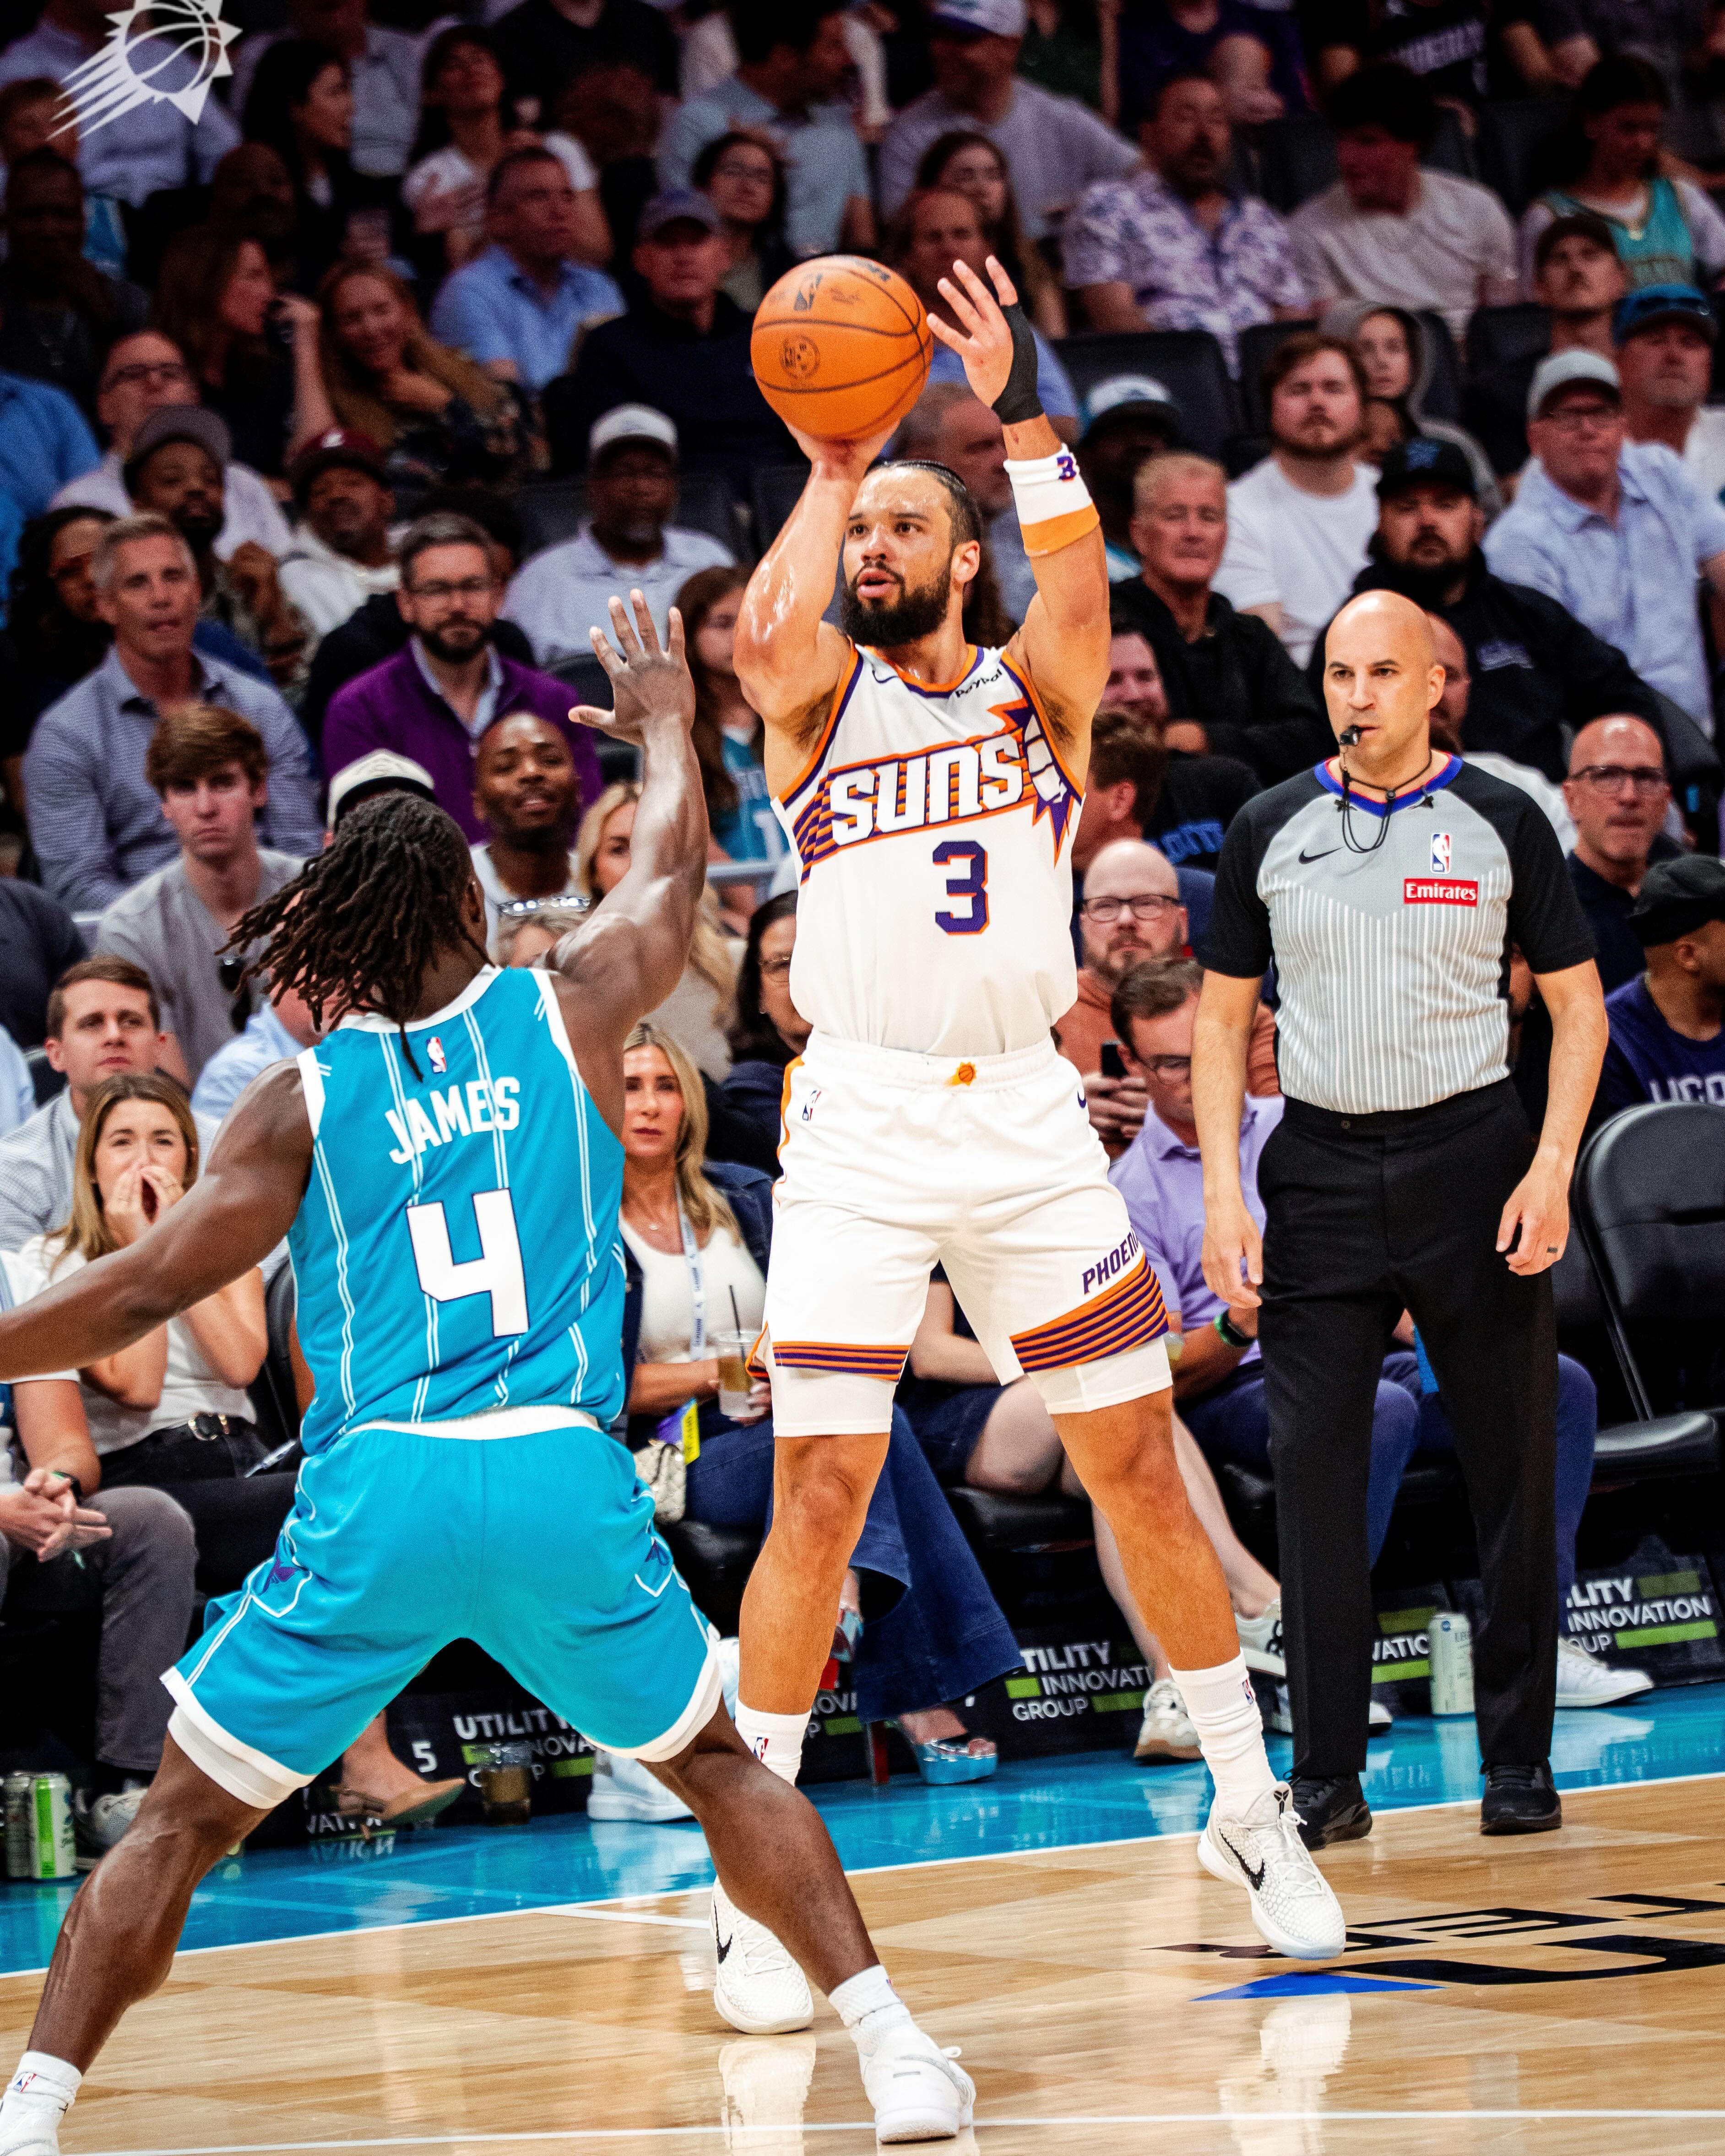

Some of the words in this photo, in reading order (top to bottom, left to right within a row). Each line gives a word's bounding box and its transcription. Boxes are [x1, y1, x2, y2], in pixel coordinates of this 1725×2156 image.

[1057, 455, 1077, 483] 3
[932, 840, 990, 935] 3
[1405, 883, 1476, 901] Emirates
[385, 1077, 520, 1165] JAMES
[406, 1187, 529, 1339] 4
[1568, 1596, 1712, 1632] INNOVATION
[1012, 1696, 1088, 1721] GROUP
[412, 1740, 438, 1773] 5
